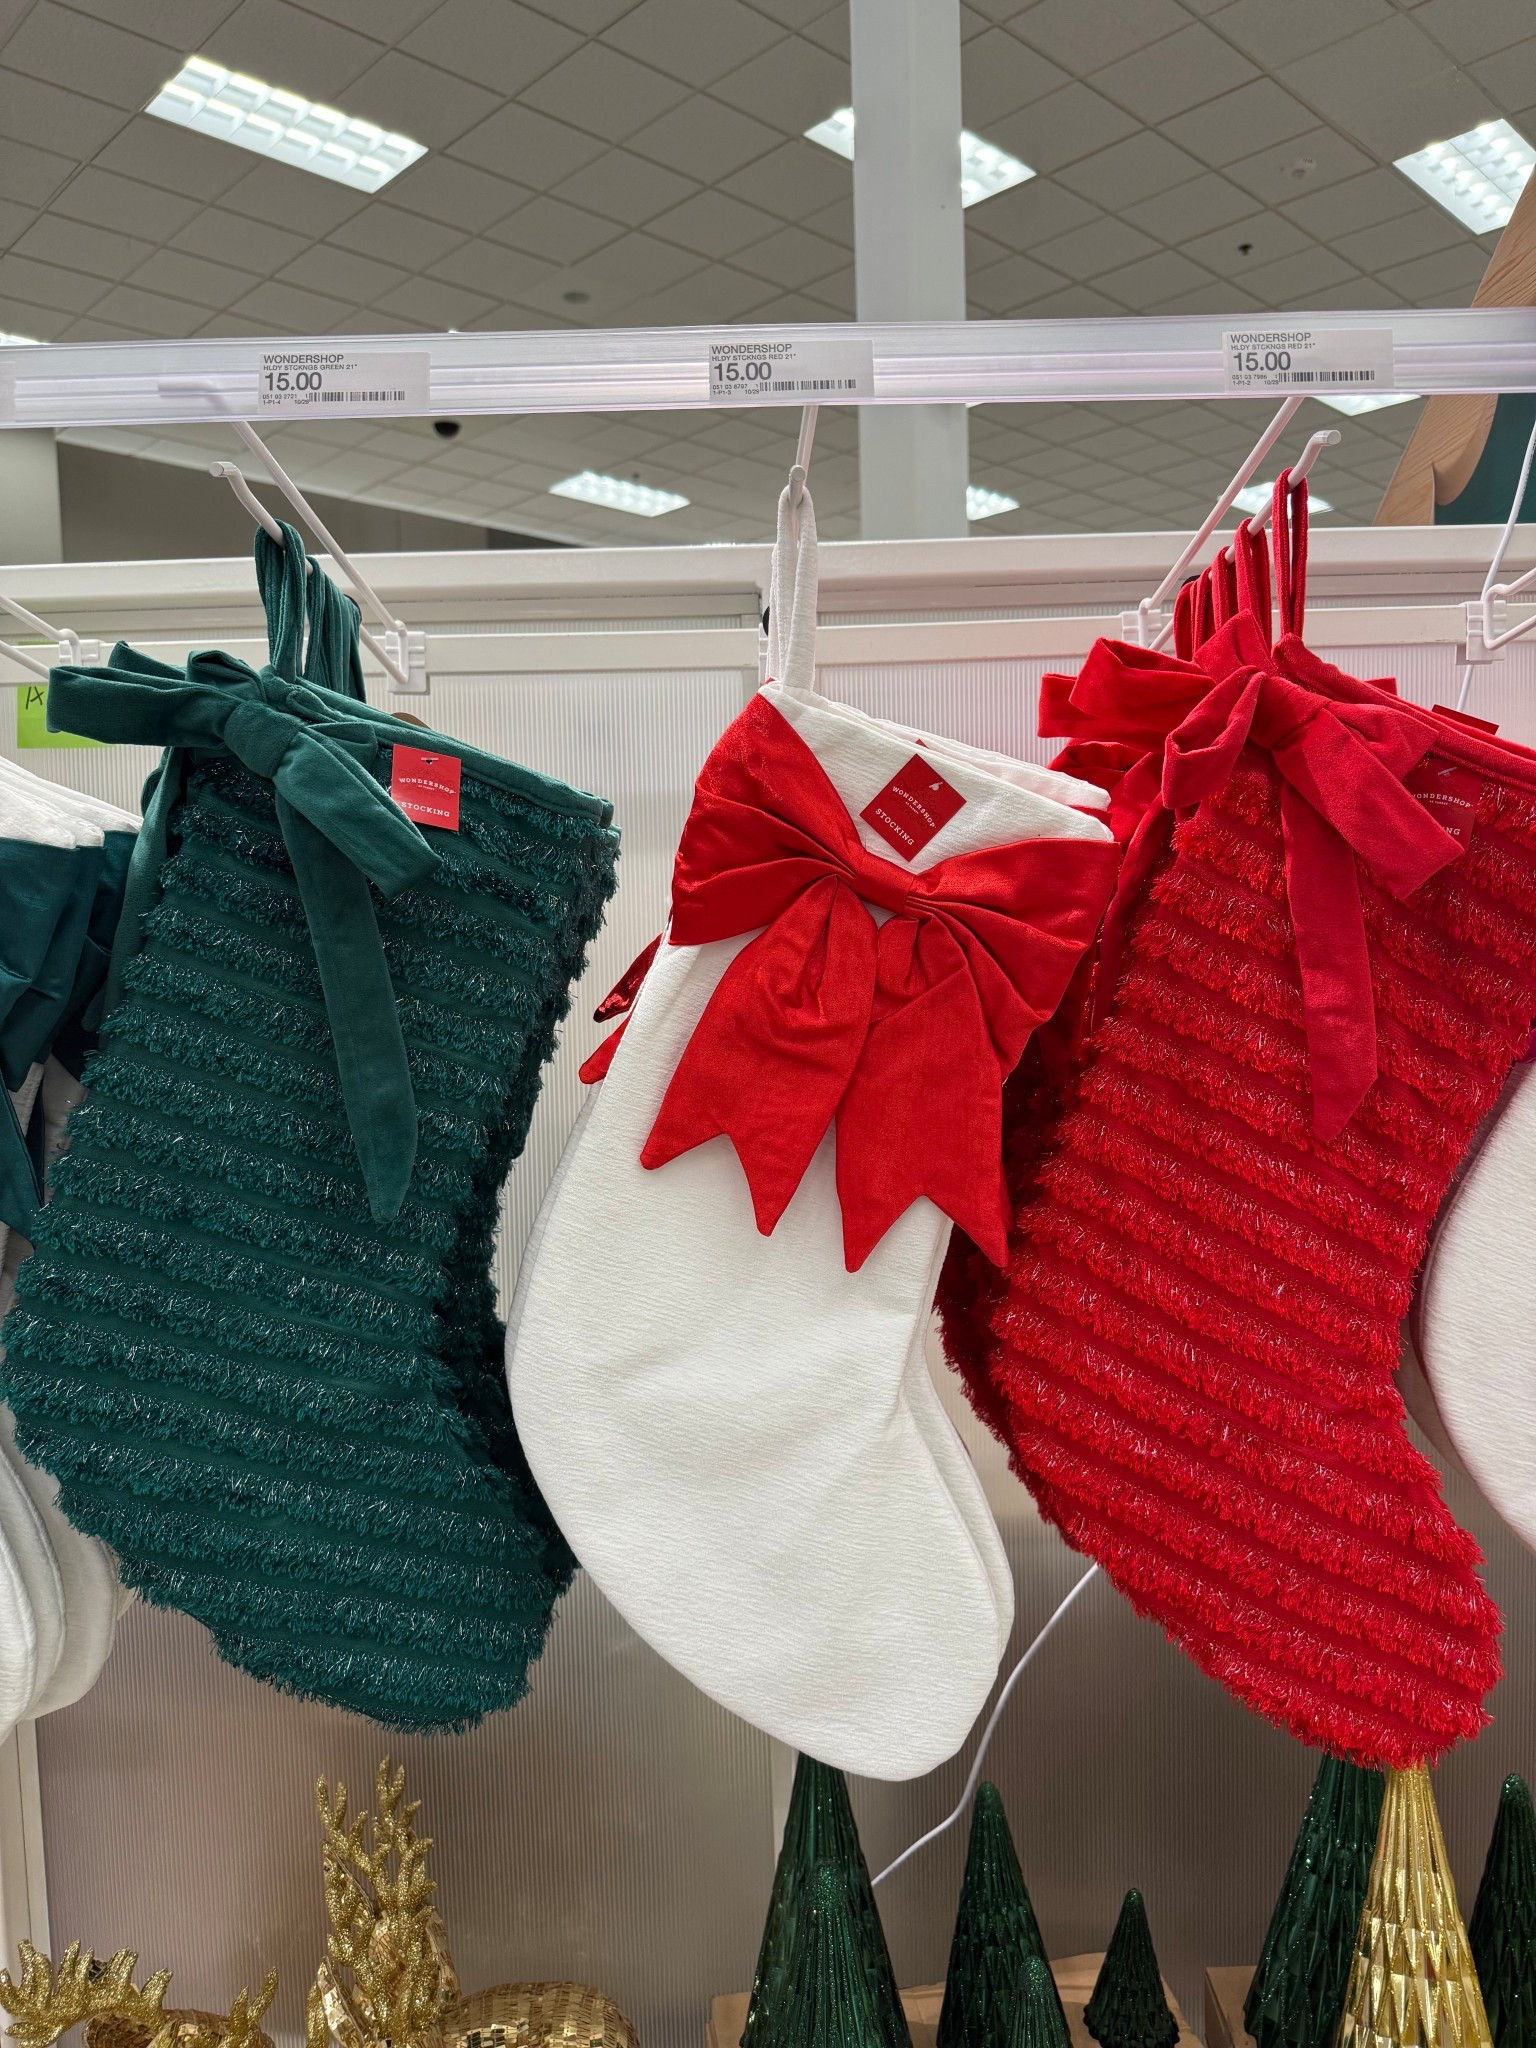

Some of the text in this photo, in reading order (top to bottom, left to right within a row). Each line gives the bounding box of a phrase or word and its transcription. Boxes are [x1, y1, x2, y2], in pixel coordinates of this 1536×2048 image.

[1231, 333, 1311, 343] WONDERSHOP
[712, 344, 792, 354] WONDERSHOP
[263, 354, 344, 364] WONDERSHOP
[1234, 352, 1291, 371] 15.00
[714, 362, 772, 381] 15.00
[265, 372, 322, 391] 15.00
[399, 777, 455, 794] WONDERSHOP
[892, 786, 936, 828] WONDERSHOP
[1413, 793, 1471, 808] ONDERSHOP
[401, 802, 450, 817] STOCKING
[875, 808, 915, 846] STOCKING
